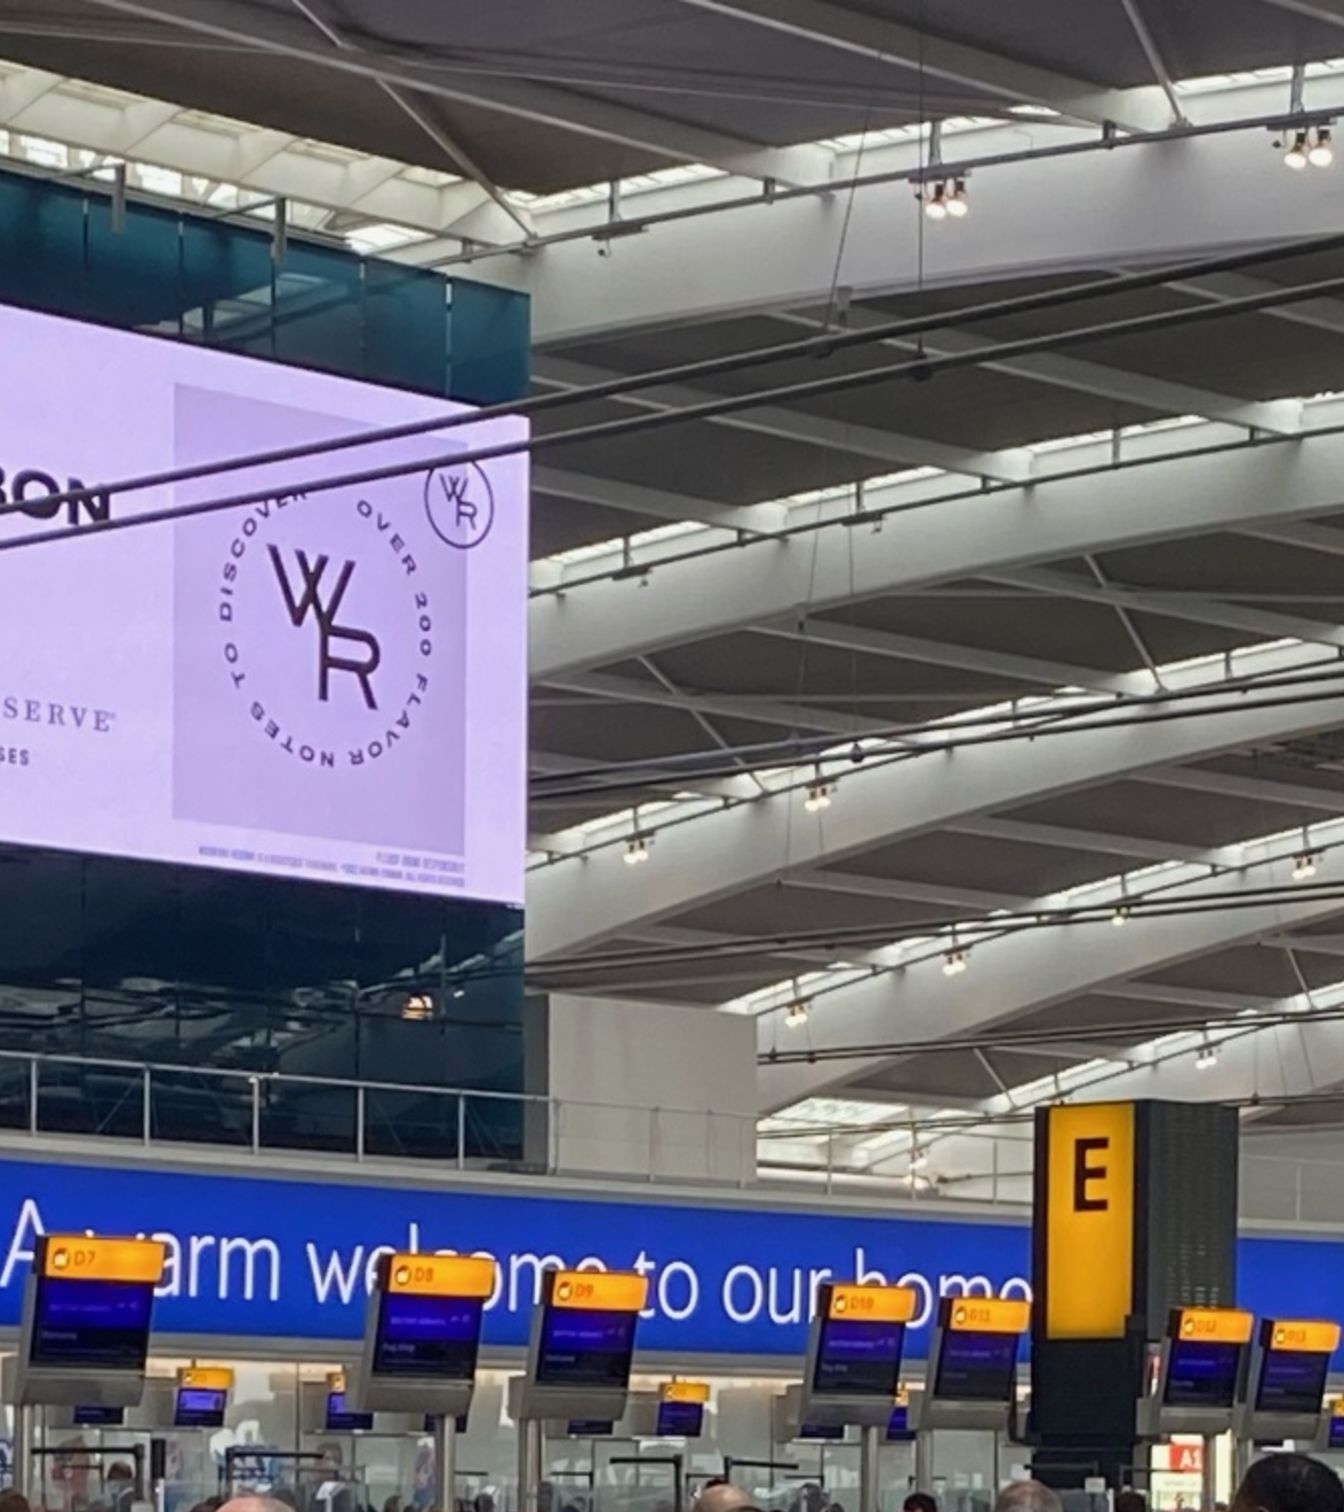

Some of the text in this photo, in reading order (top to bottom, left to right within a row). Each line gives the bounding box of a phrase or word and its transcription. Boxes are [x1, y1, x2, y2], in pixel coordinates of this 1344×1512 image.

[357, 499, 417, 576] OVER
[414, 592, 432, 657] 200
[224, 642, 246, 689] TO
[249, 701, 335, 768] NOTES
[348, 672, 429, 765] FLAVOR
[1073, 1137, 1110, 1212] E
[74, 1249, 96, 1266] D7
[414, 1266, 434, 1283] D8
[574, 1282, 595, 1299] D9
[632, 1250, 699, 1320] to
[722, 1264, 832, 1324] our
